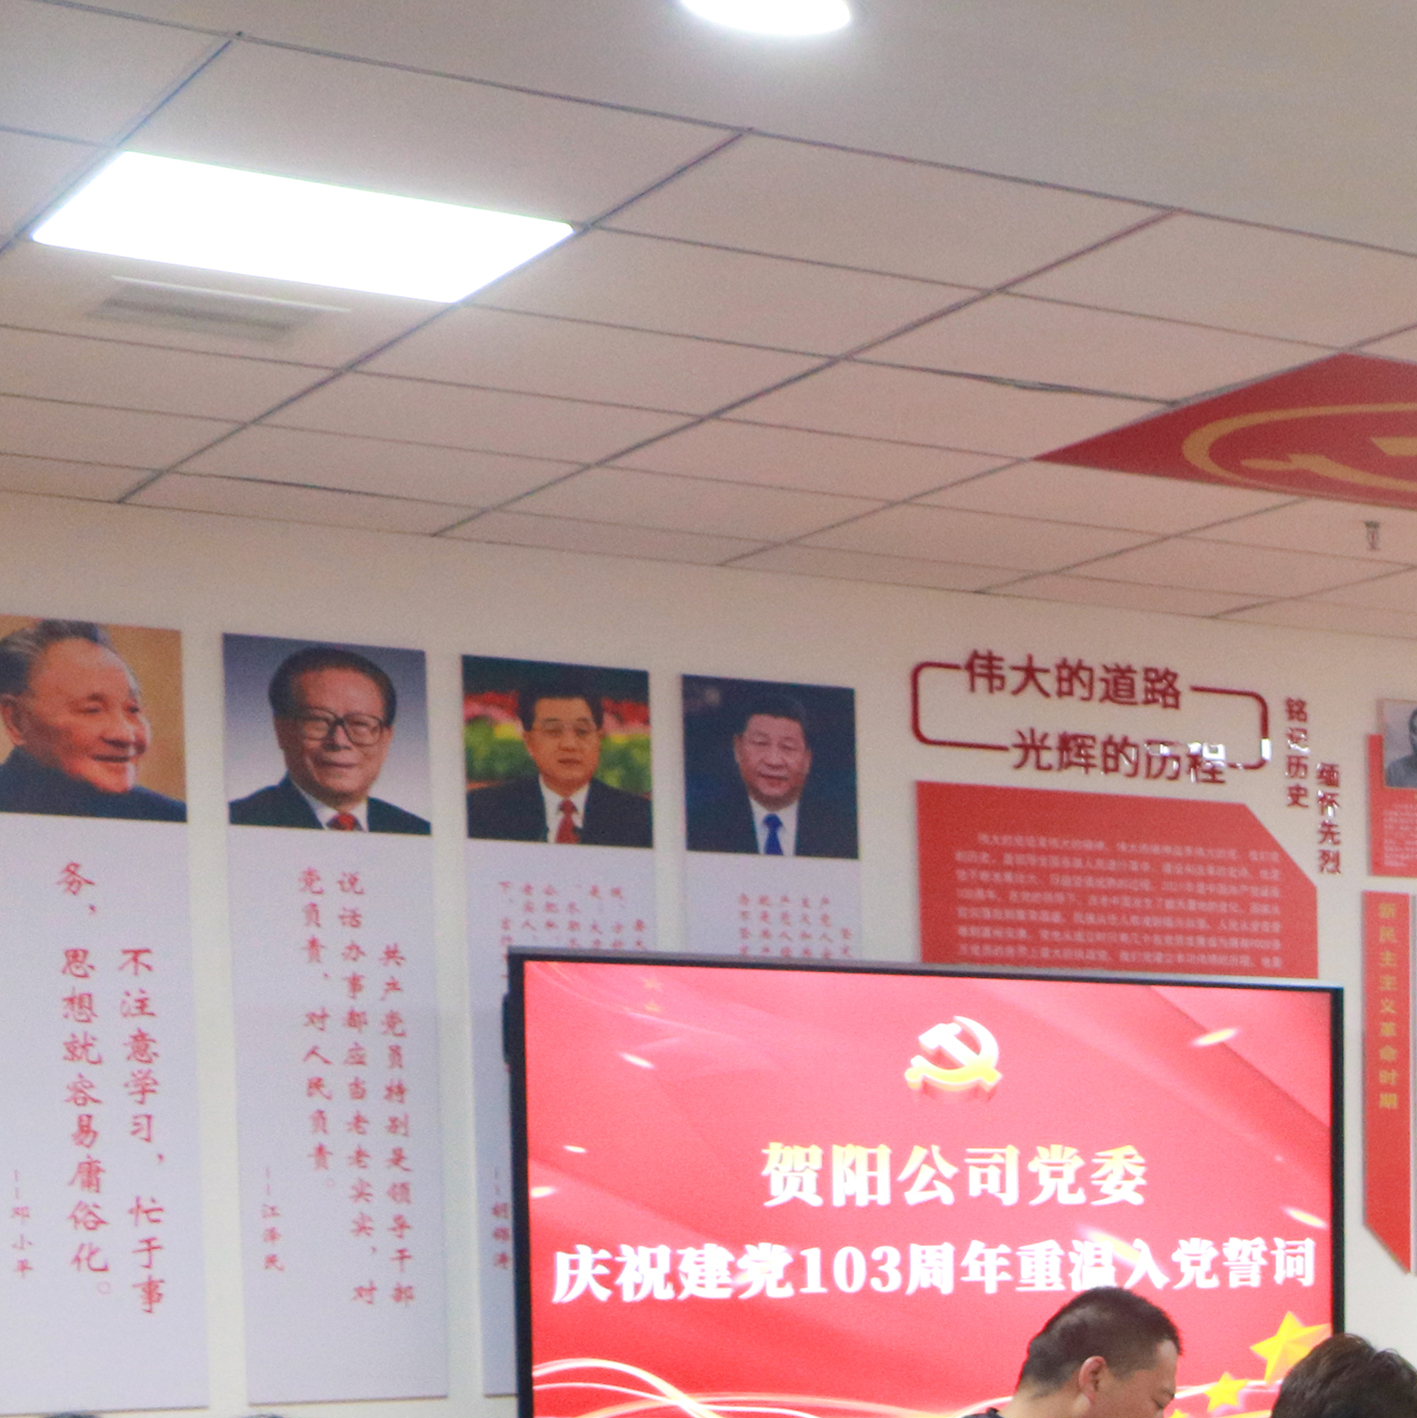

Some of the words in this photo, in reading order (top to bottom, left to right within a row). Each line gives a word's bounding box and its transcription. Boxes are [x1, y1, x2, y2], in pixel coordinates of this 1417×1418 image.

[965, 650, 1182, 709] 伟大的道路
[1012, 728, 1227, 784] 光辉的历程
[1379, 902, 1399, 1110] 新民主主义革命时期
[57, 862, 112, 1295] 务，思想就容易庸俗化。
[118, 947, 168, 1314] 不注意学习，忙于事
[762, 1141, 1147, 1207] 贺阳公司党委
[552, 1235, 1316, 1303] 庆祝建党103周年重温入党誓词
